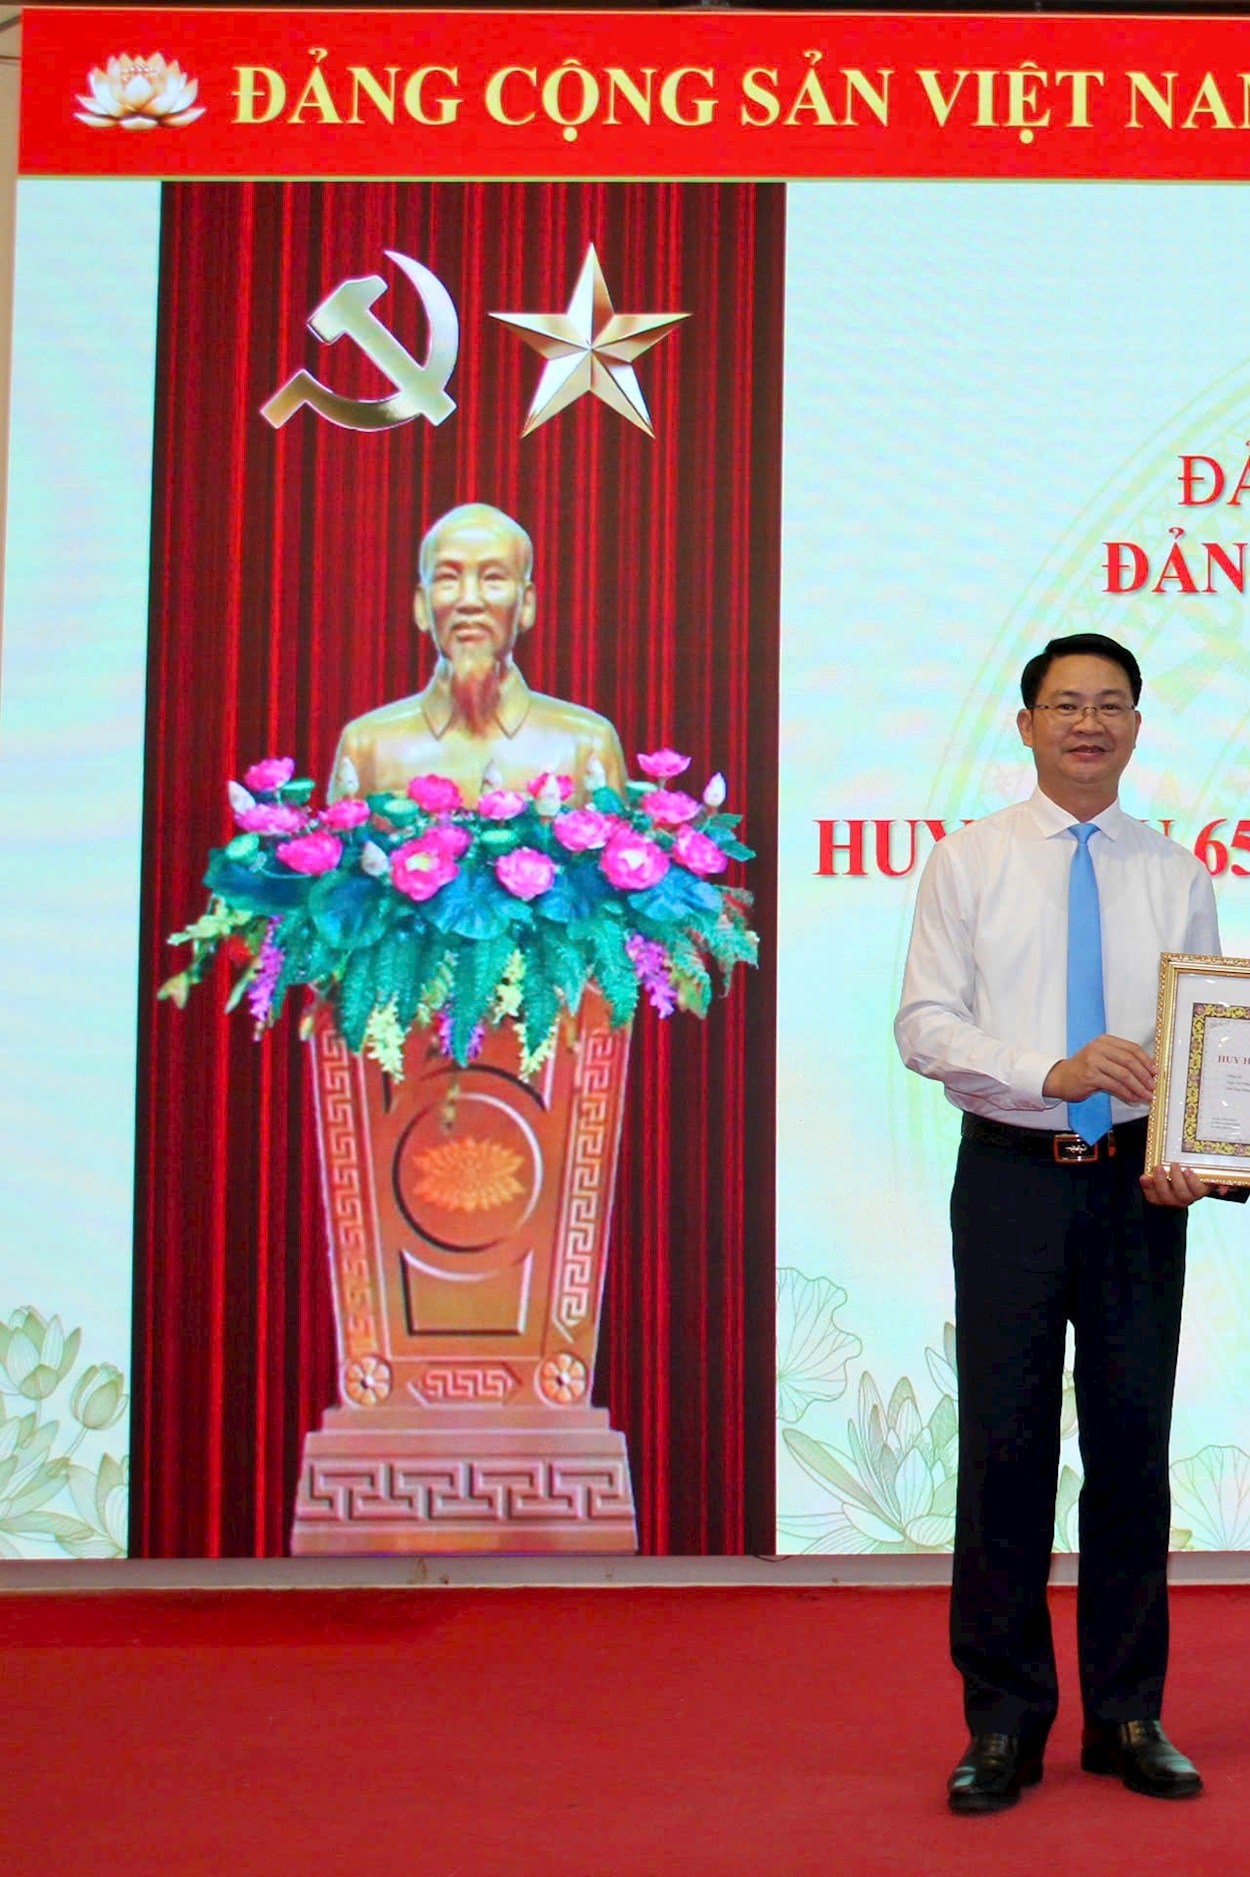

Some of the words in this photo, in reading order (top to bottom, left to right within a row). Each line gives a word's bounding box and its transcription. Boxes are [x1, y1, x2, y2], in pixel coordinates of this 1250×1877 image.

[232, 47, 463, 126] ĐẢNG
[485, 58, 719, 142] CỘNG
[741, 50, 894, 127] SẢN
[915, 61, 1105, 144] VIỆT
[1217, 1055, 1241, 1065] HUY
